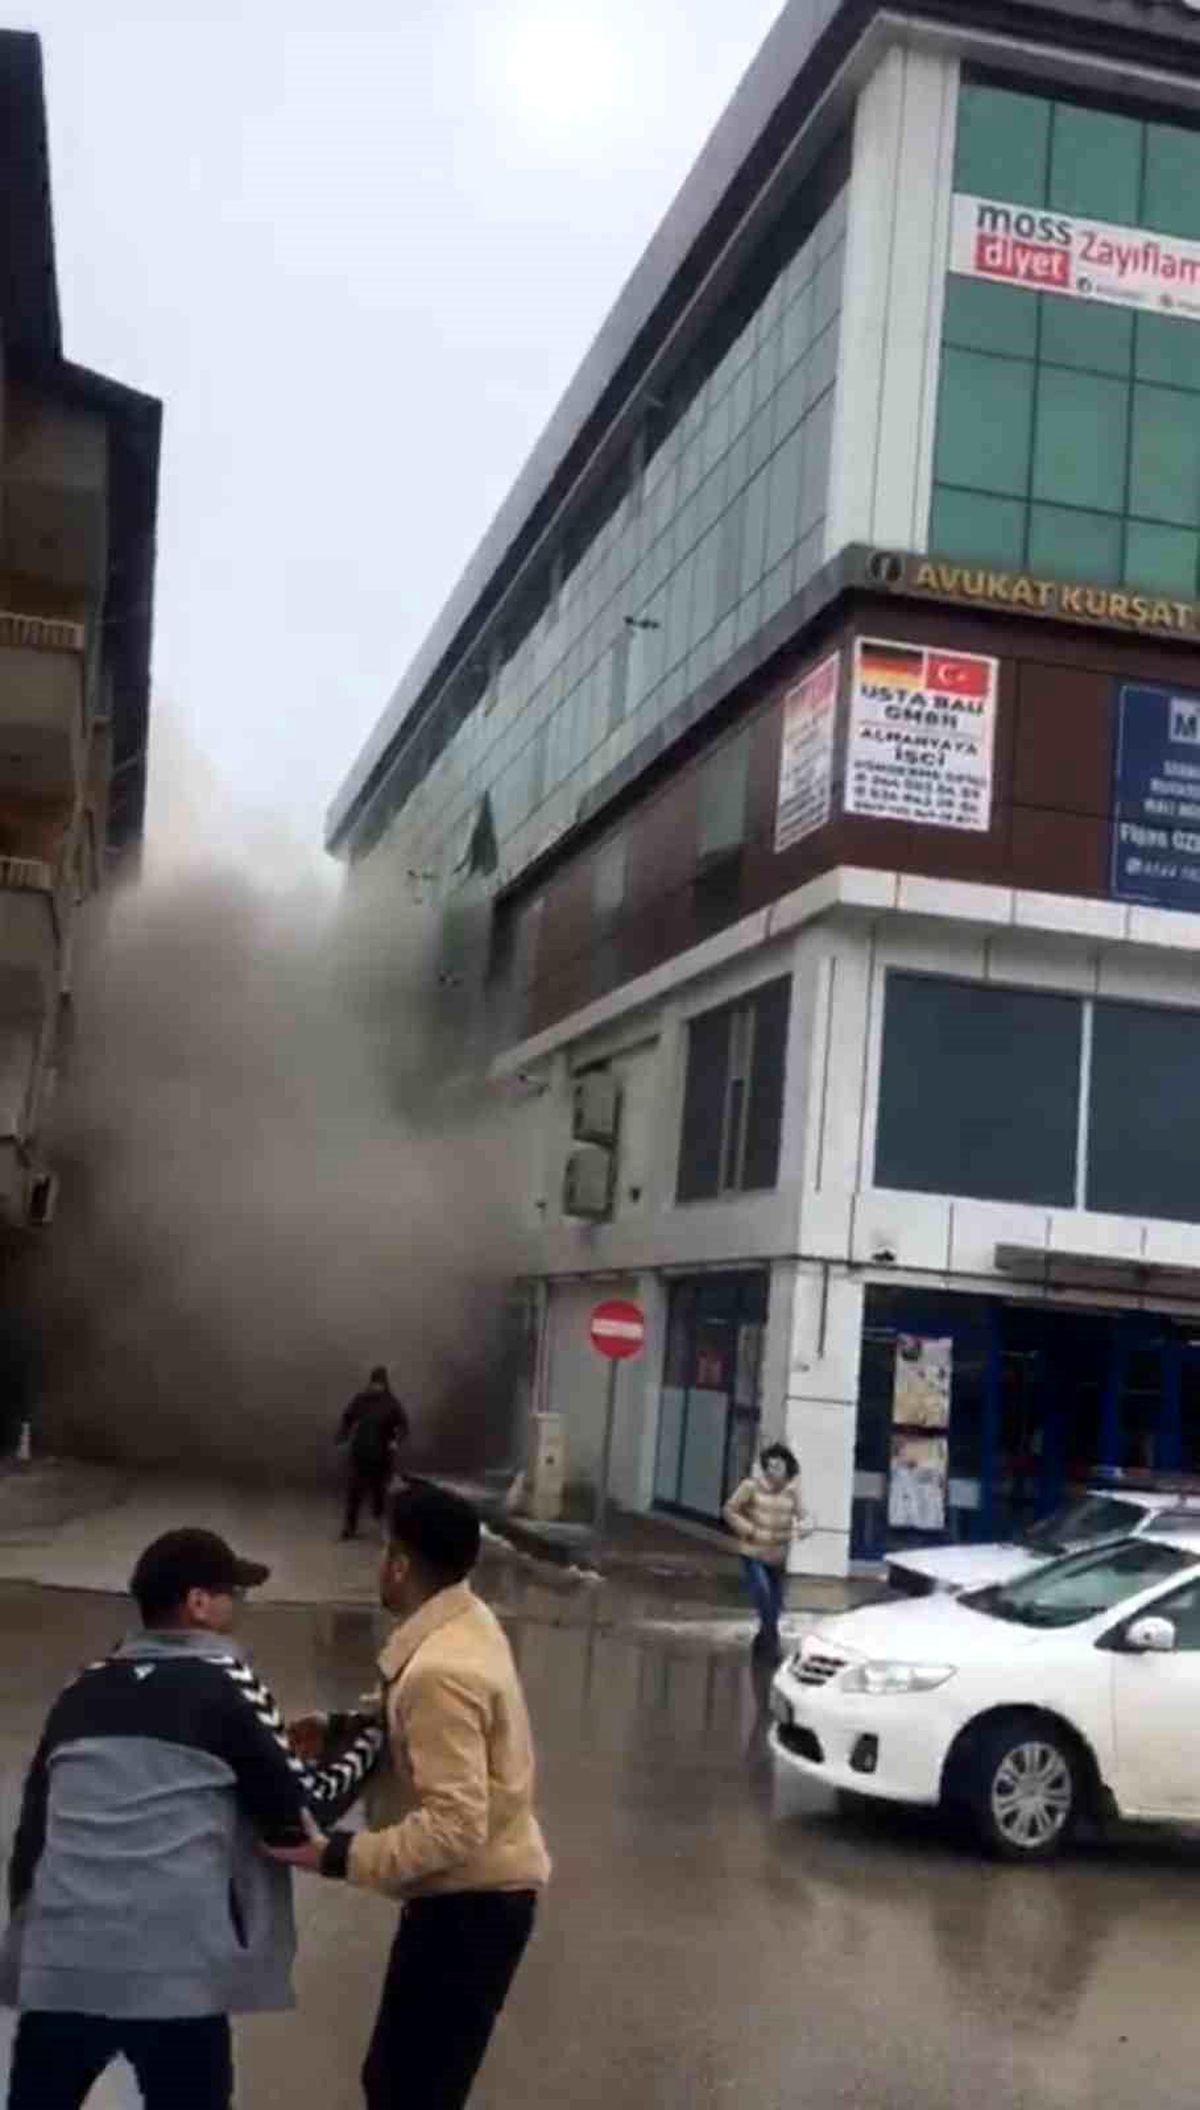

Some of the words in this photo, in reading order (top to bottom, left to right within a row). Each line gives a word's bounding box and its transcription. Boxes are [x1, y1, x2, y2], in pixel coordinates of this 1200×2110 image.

[976, 203, 1073, 246] moss
[984, 236, 1064, 281] diyet
[916, 562, 1055, 607] AVUKAT
[860, 684, 928, 708] USTA
